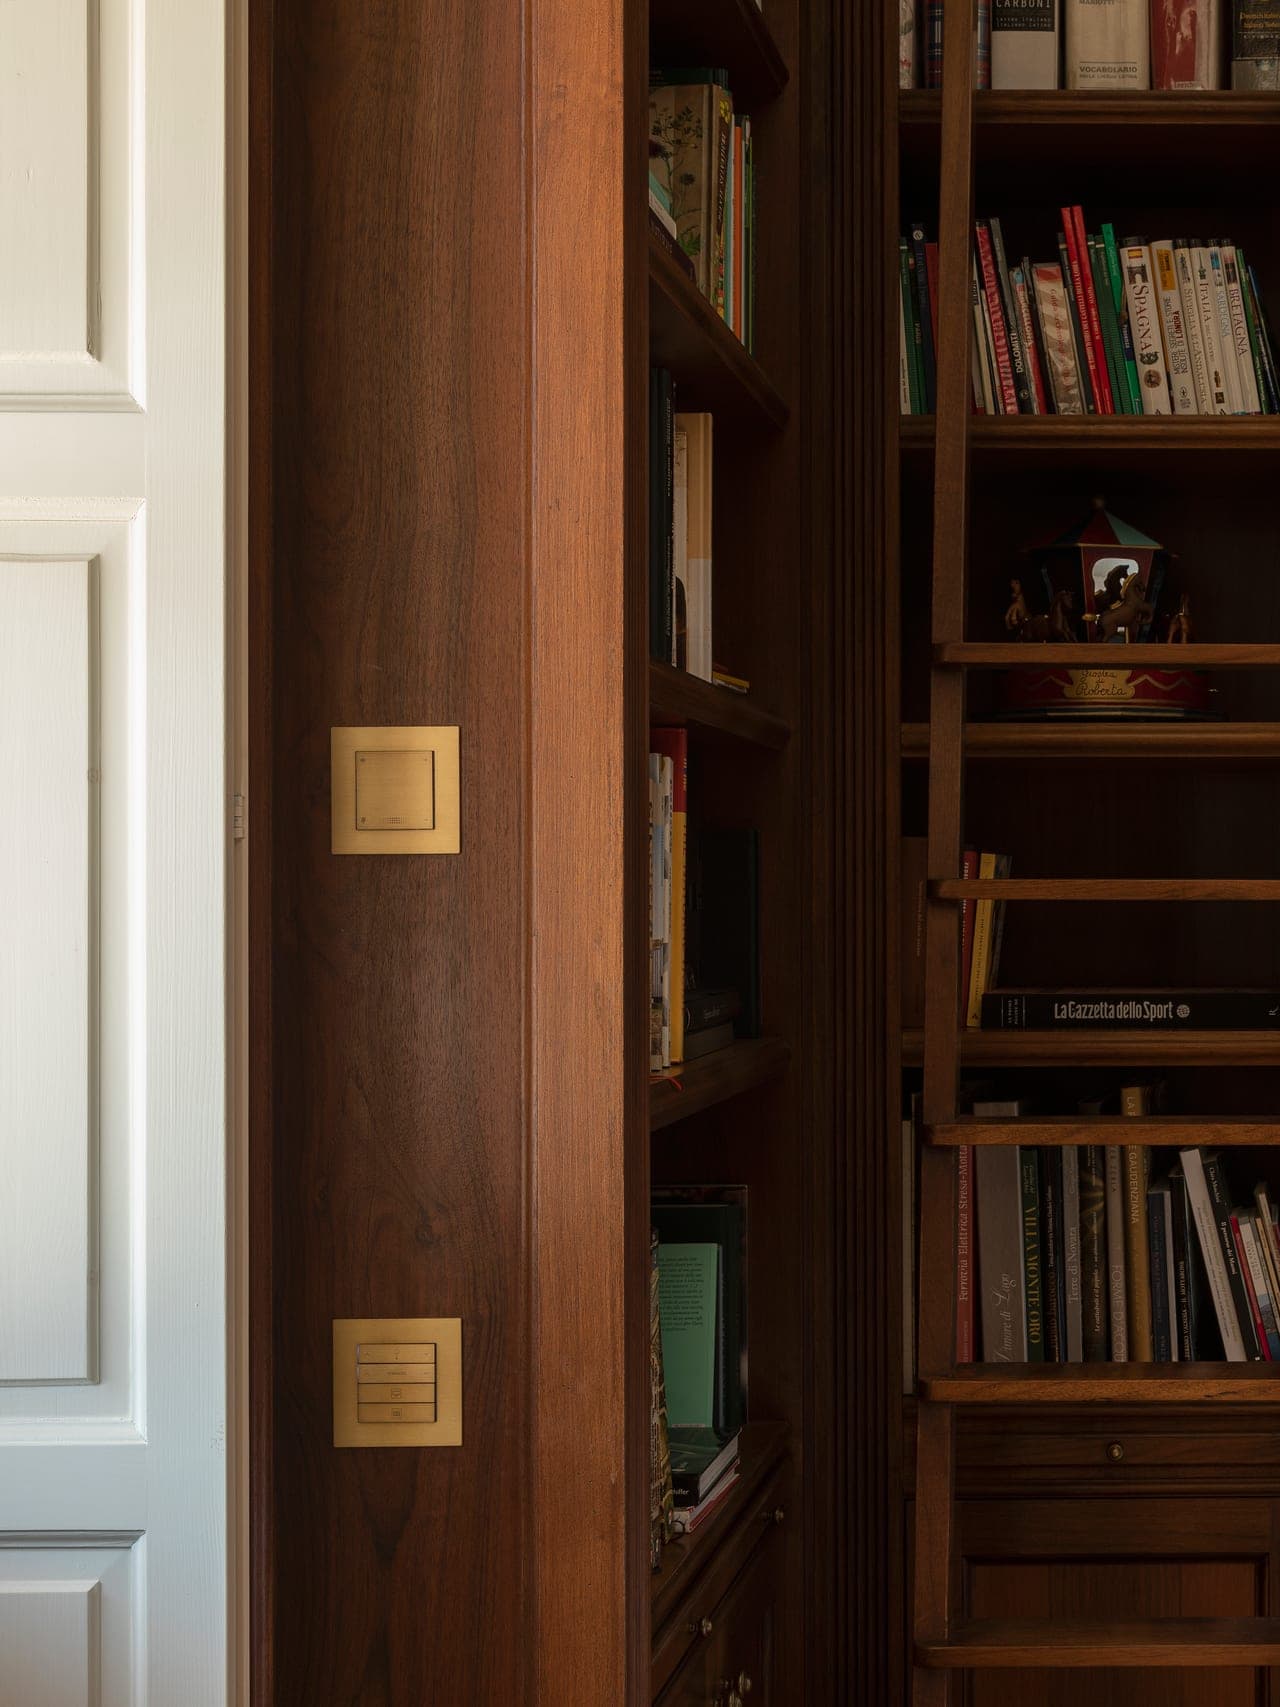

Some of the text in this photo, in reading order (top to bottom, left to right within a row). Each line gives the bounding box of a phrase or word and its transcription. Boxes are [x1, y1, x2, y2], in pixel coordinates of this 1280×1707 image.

[1132, 284, 1153, 351] SPAGNA
[1199, 281, 1212, 323] ITALIA
[1217, 290, 1230, 337] SARDEGNA
[1229, 288, 1248, 355] BRETAGNA
[1173, 310, 1184, 339] LONDRA
[1014, 334, 1025, 373] DOLOMITI
[1075, 684, 1127, 696] Roberta
[1126, 1095, 1136, 1109] LA
[1129, 1151, 1138, 1224] GAUDENZIANA
[957, 1145, 968, 1301] Ferrovia Elettrica Stresa-Motta
[1026, 1205, 1038, 1252] VILLA
[1067, 1226, 1077, 1261] Novara
[1025, 1254, 1040, 1307] MONTE
[1066, 1264, 1078, 1275] di
[1027, 1310, 1041, 1344] ORO
[1110, 1264, 1125, 1362] FORME D'ACQU
